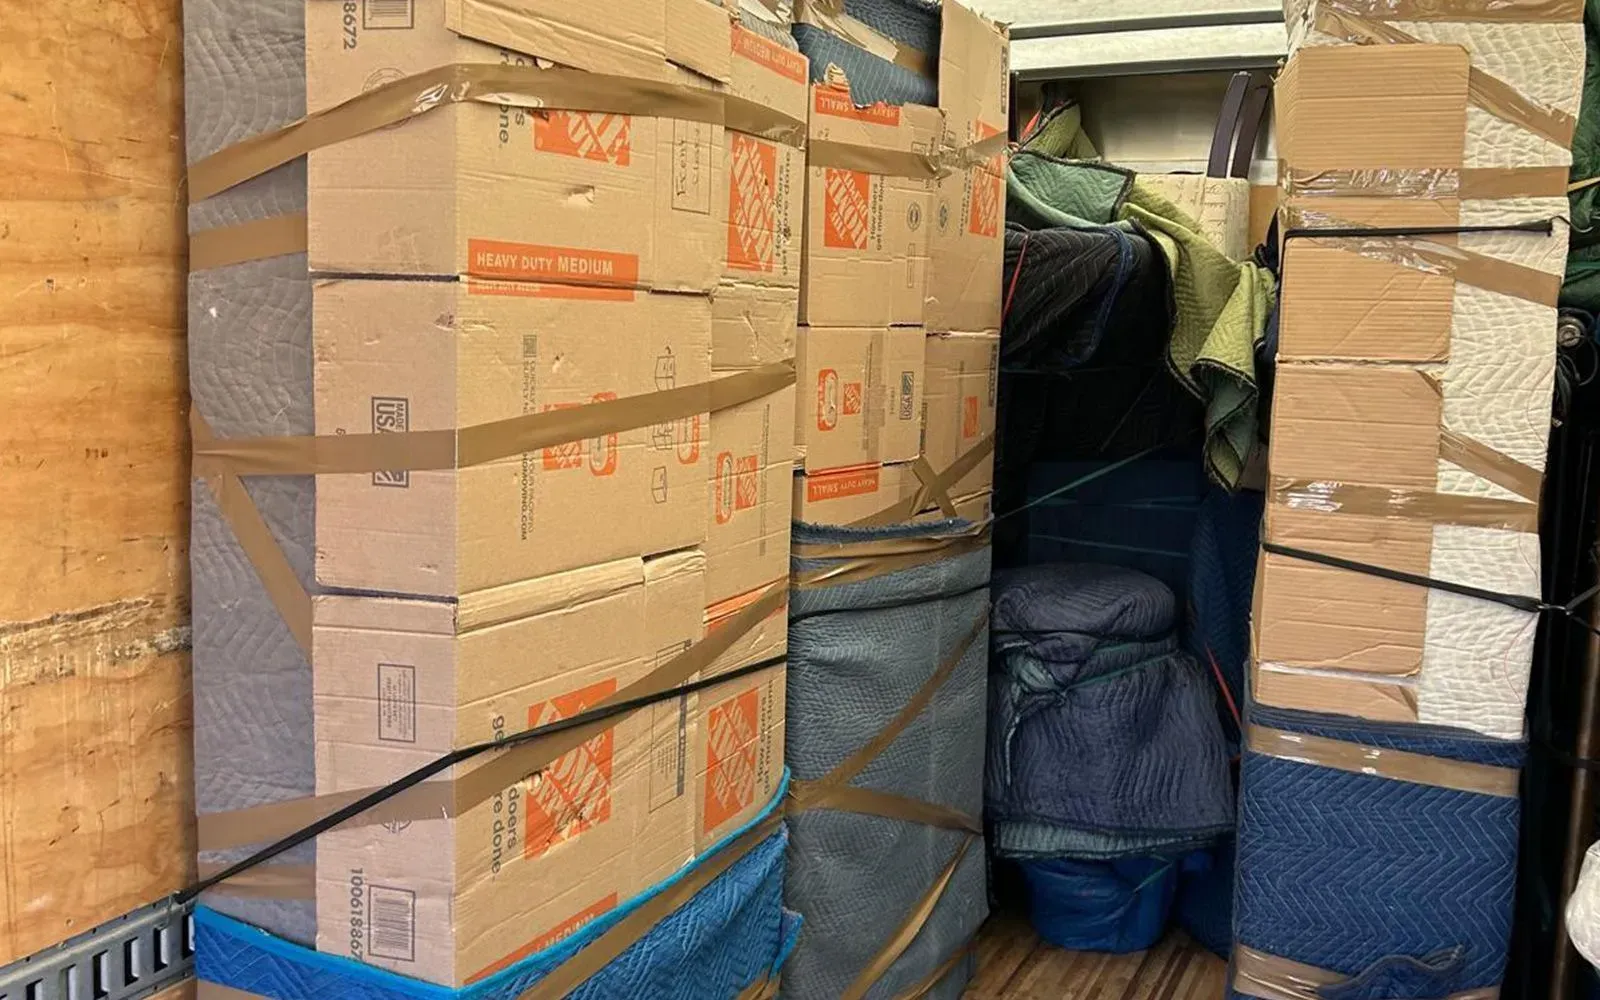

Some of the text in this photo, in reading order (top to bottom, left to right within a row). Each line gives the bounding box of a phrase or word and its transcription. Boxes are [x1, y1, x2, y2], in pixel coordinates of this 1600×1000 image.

[343, 3, 357, 49] 8672
[498, 96, 509, 148] one.
[820, 98, 849, 112] SMALL
[731, 136, 771, 269] HOME
[776, 164, 784, 213] doers
[825, 168, 866, 248] HOME
[828, 207, 846, 239] THE
[477, 252, 613, 276] HEAVY DUTY MEDIUM
[396, 403, 404, 430] MADE
[901, 395, 912, 417] USA
[813, 483, 838, 496] SMALL
[841, 481, 856, 489] DUTY
[708, 706, 752, 808] HOME
[757, 747, 765, 784] How
[507, 788, 521, 850] doers
[350, 868, 363, 961] 100618867
